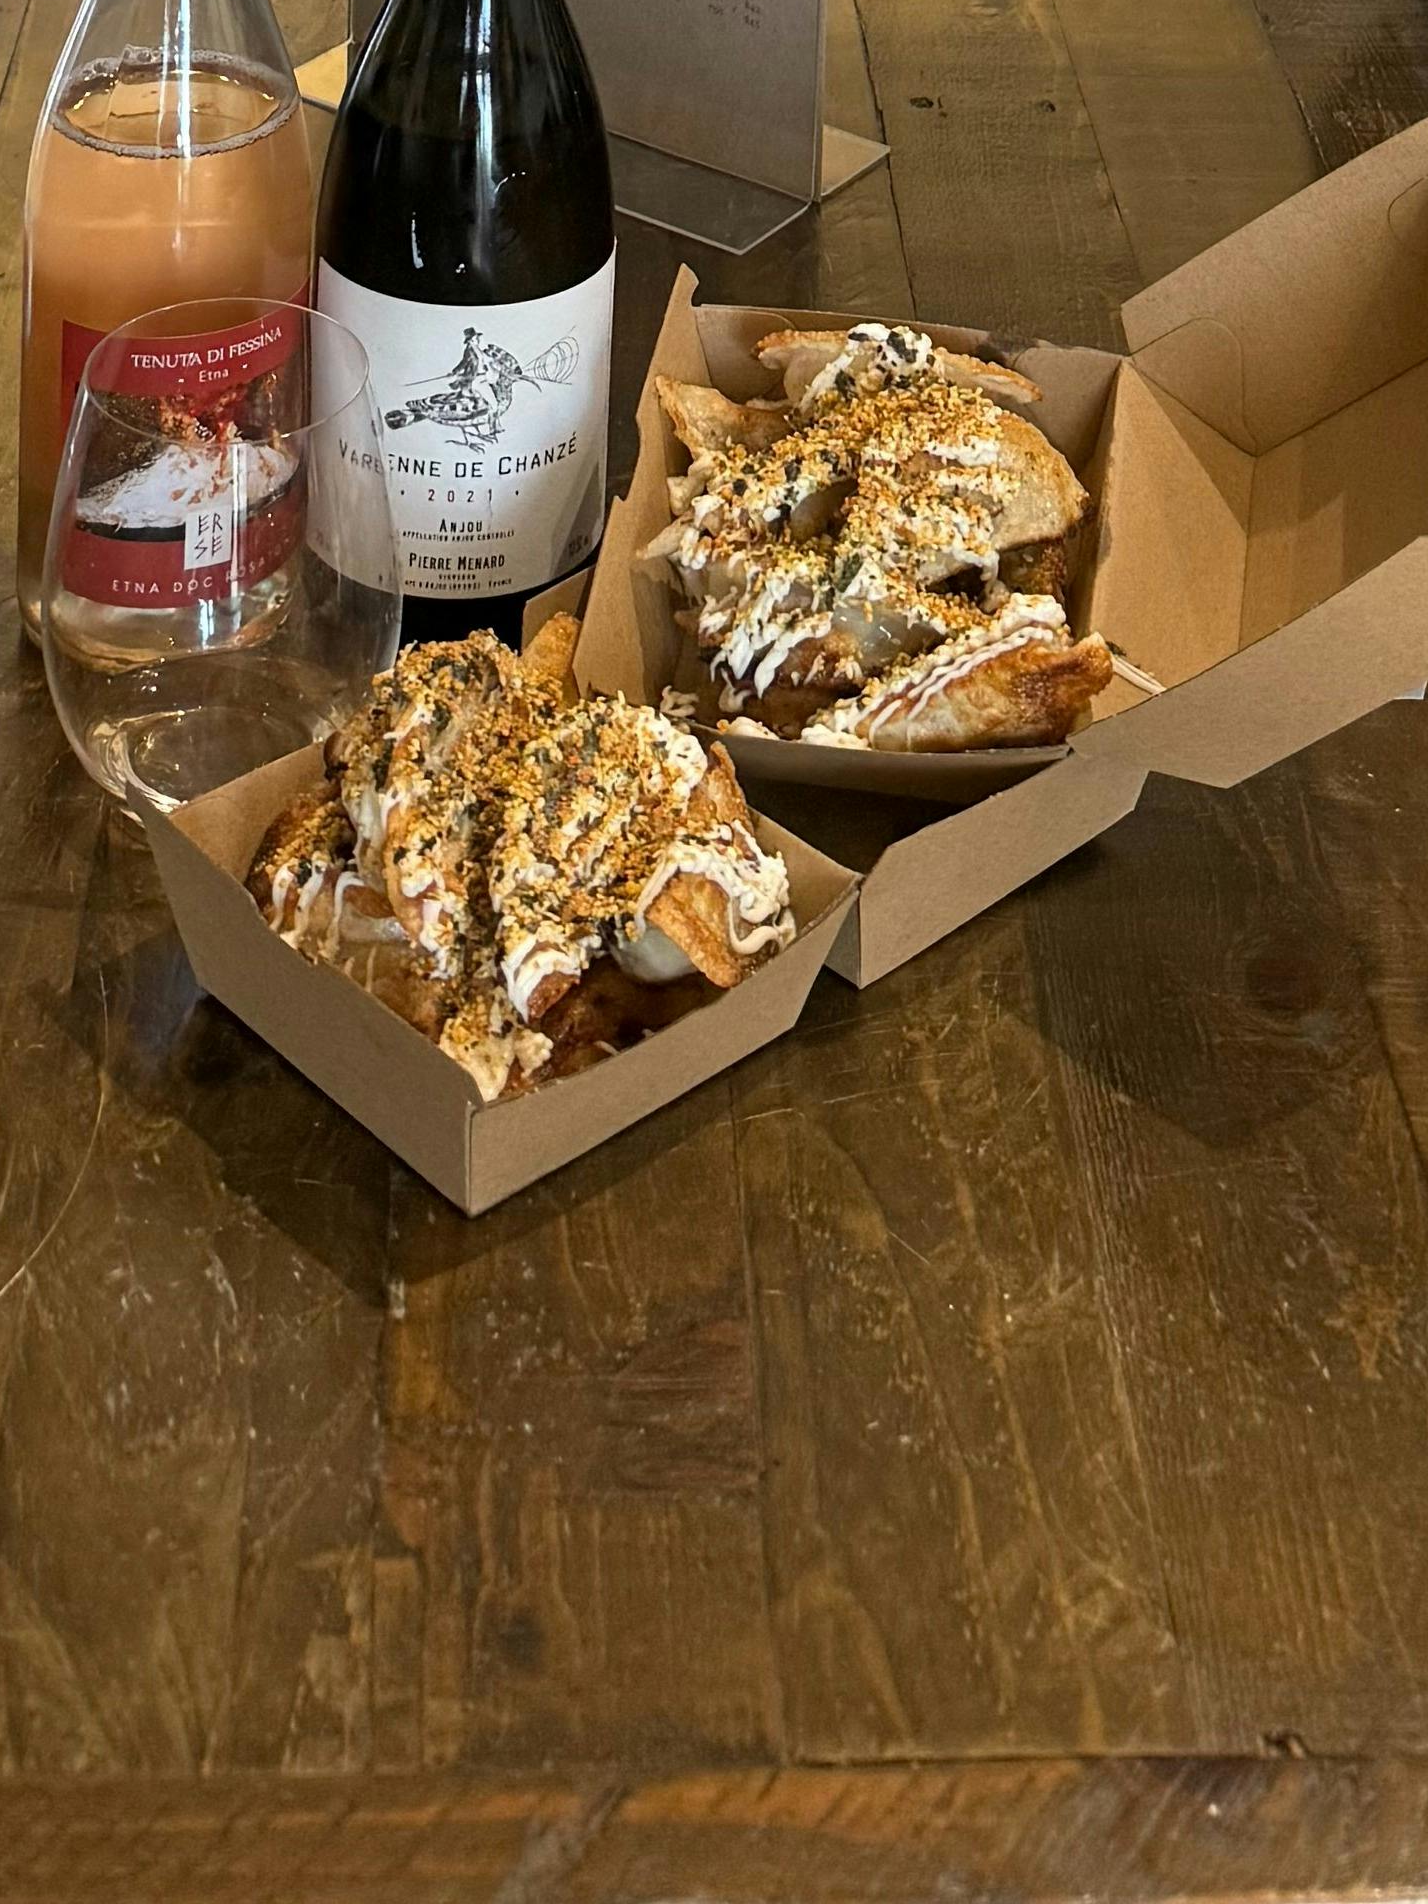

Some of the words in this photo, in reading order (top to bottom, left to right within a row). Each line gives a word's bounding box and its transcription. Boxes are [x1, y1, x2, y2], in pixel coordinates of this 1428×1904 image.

[130, 351, 202, 369] TENUTA
[207, 348, 224, 364] DI
[229, 326, 282, 359] FESSINA
[198, 367, 230, 383] Etna
[455, 461, 484, 479] DE
[427, 488, 494, 504] 2021
[439, 518, 483, 533] ANJOU
[409, 552, 453, 571] PIERRE
[457, 553, 505, 571] MENARD
[112, 579, 160, 594] ETNA
[173, 576, 213, 593] DOC
